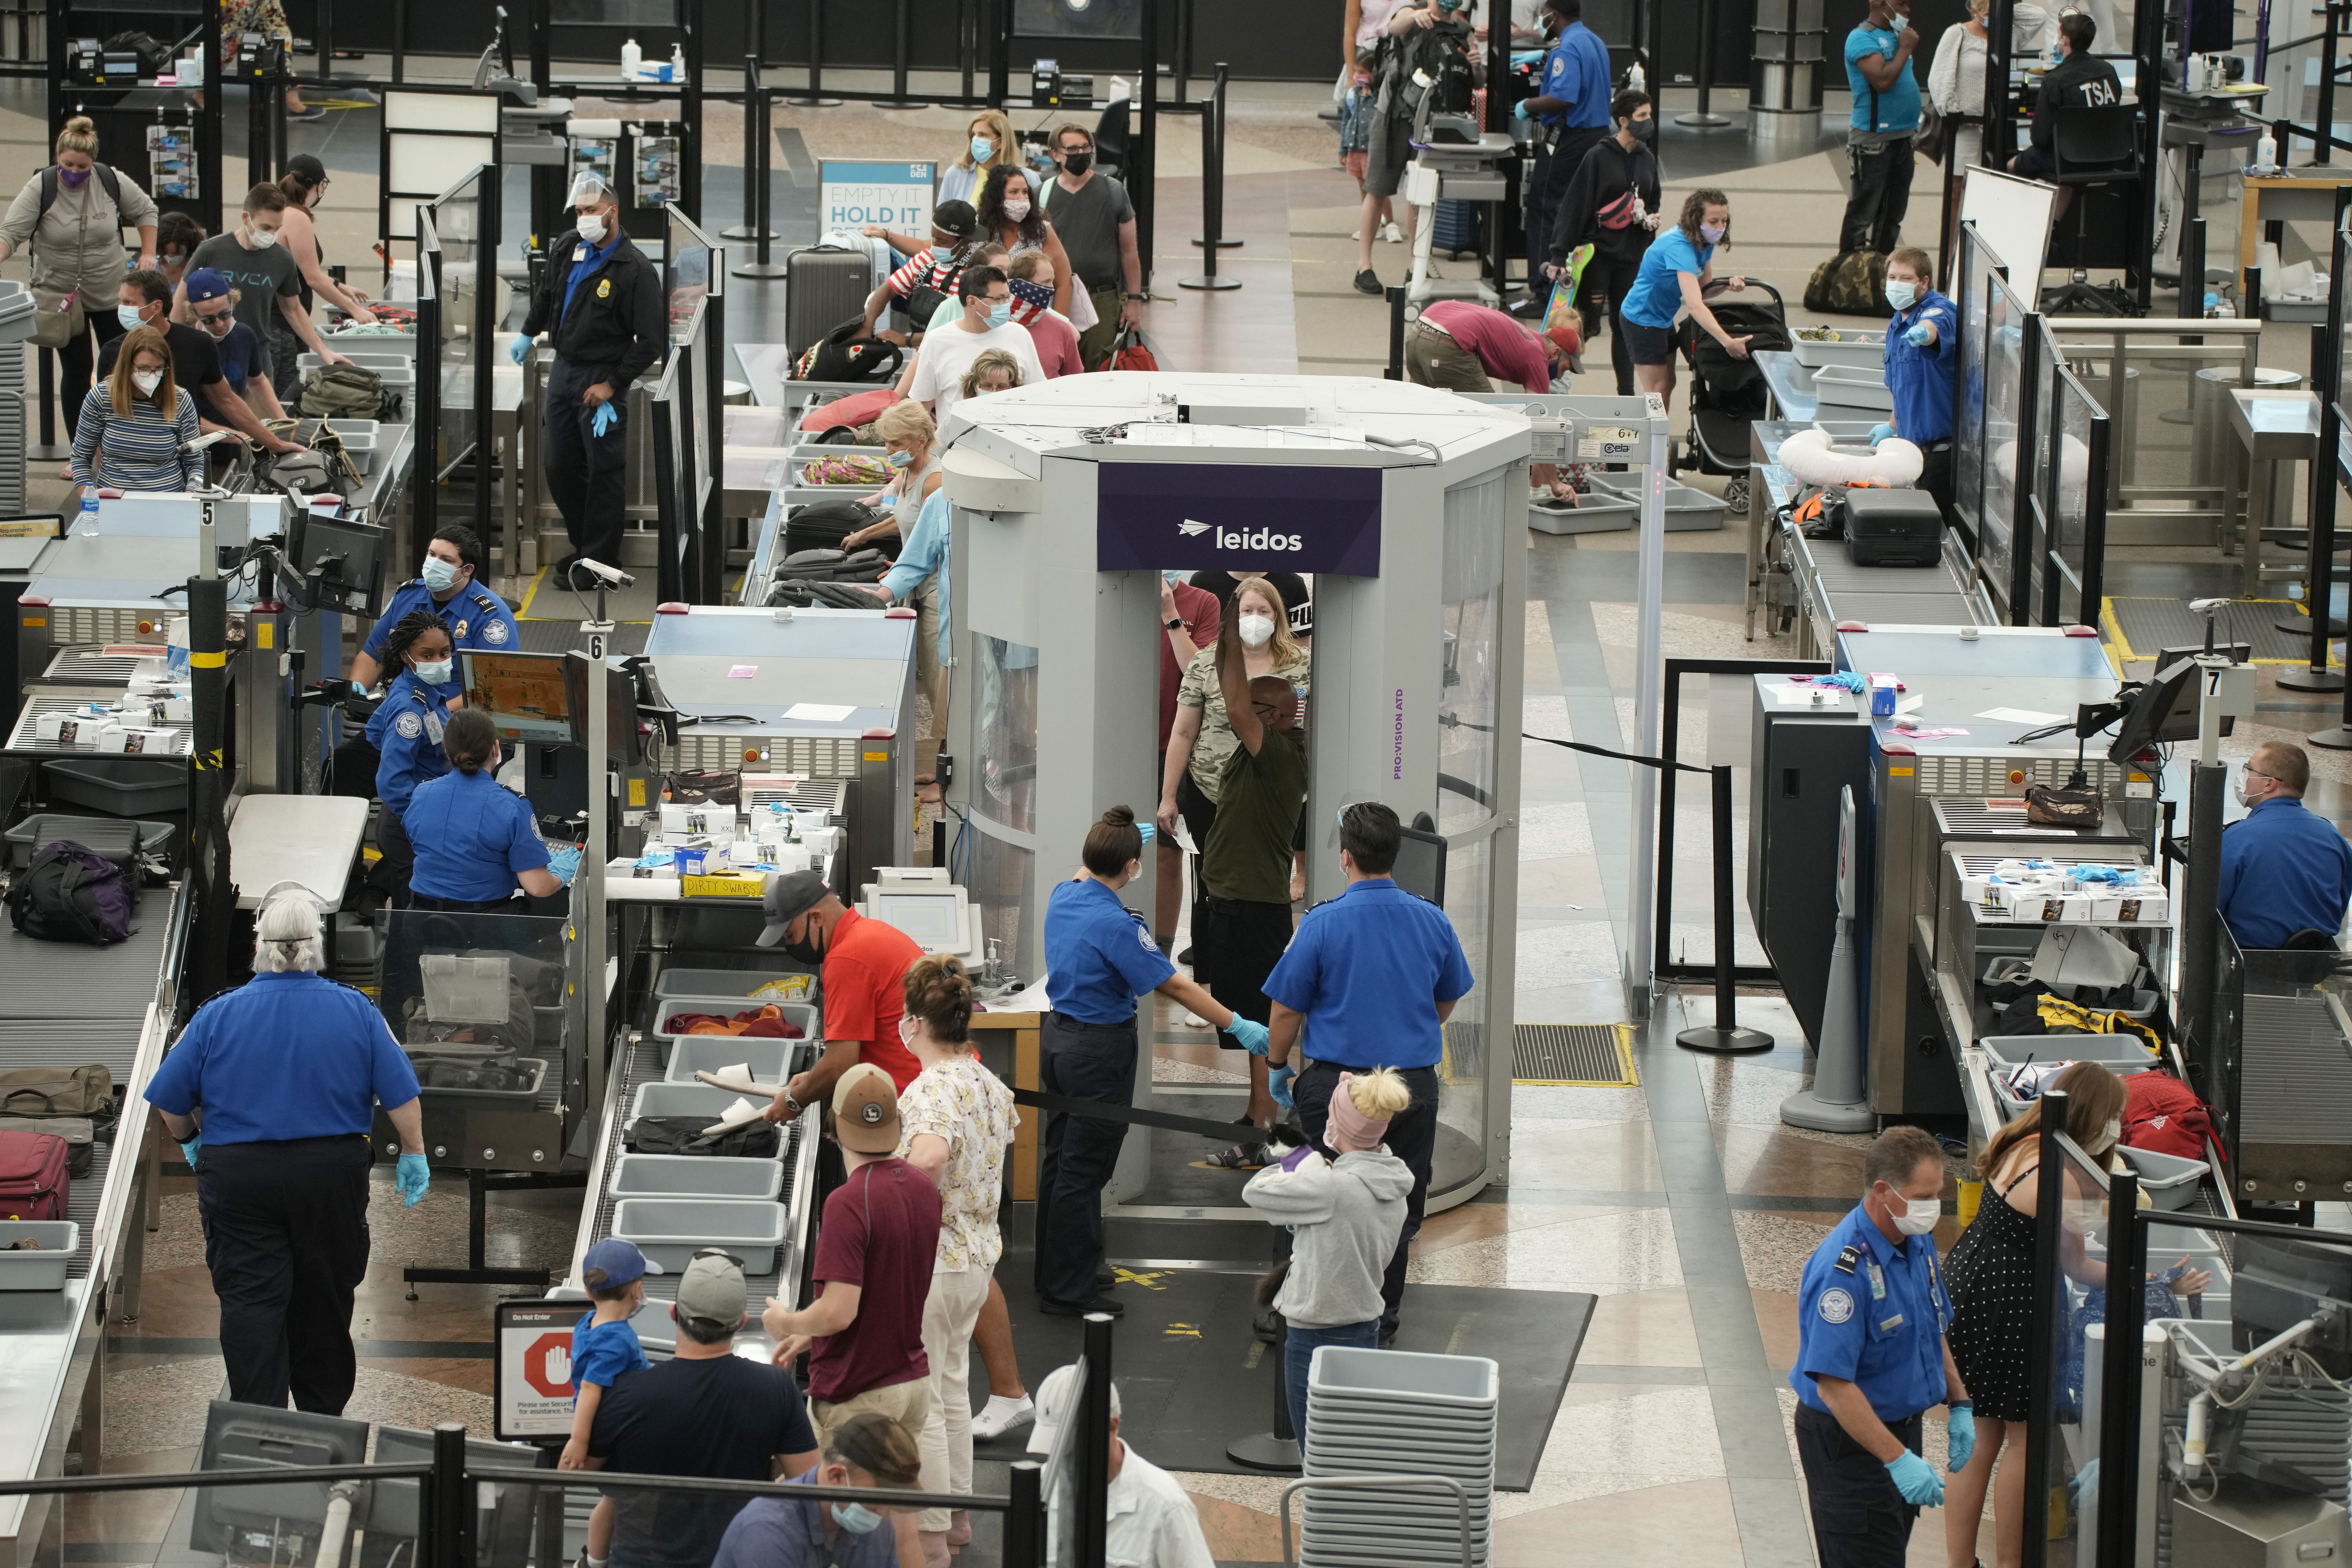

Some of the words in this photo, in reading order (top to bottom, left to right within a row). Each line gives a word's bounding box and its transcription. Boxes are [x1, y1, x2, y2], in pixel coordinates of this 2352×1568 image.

[2079, 79, 2116, 107] TSA
[832, 187, 898, 203] EMPTY
[905, 188, 921, 203] IT
[832, 206, 893, 223] HOLD
[901, 208, 921, 223] IT
[222, 271, 273, 287] RVCA
[203, 503, 212, 525] 5
[1217, 526, 1302, 551] leidos
[1289, 605, 1312, 628] PU
[591, 636, 602, 659] 6
[2208, 672, 2220, 695] 7
[1394, 713, 1403, 780] PRO:VISION
[687, 879, 718, 892] DIRTY
[723, 882, 756, 894] SWABS
[2148, 1116, 2169, 1124] GREGORY
[1841, 1252, 1855, 1264] TSA
